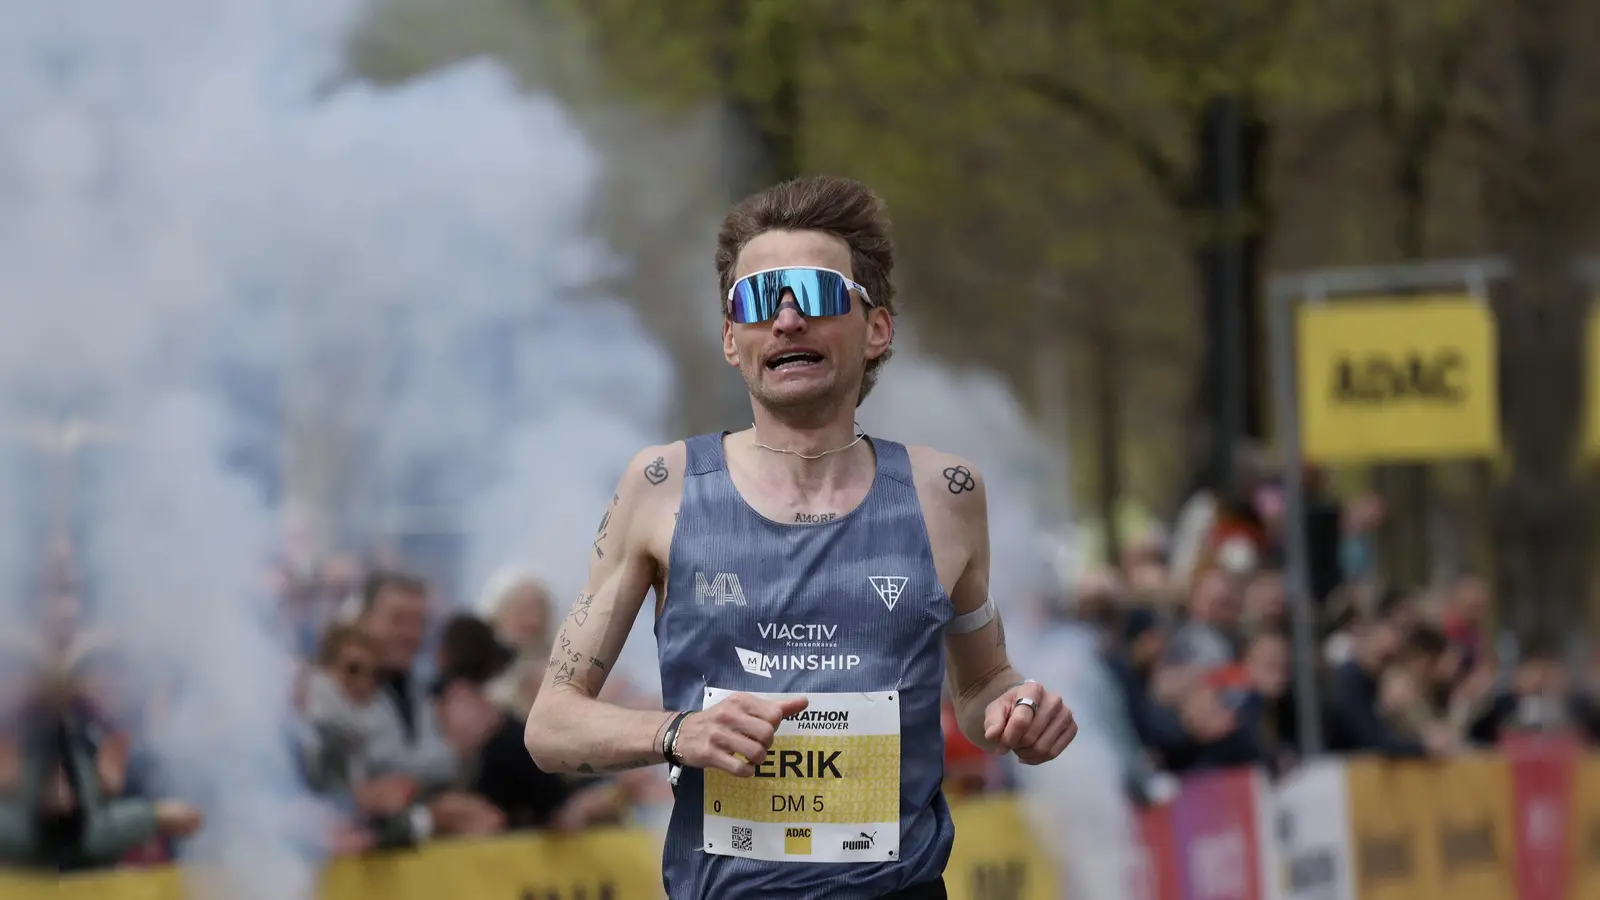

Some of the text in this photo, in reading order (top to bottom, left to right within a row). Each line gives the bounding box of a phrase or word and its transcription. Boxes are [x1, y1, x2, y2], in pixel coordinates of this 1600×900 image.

[695, 572, 747, 606] MA
[757, 622, 838, 640] VIACTIV
[761, 654, 860, 671] MINSHIP
[782, 711, 849, 722] RATHON
[797, 722, 849, 730] HANNOVER
[754, 750, 843, 779] ERIK
[713, 800, 722, 813] 0
[772, 795, 824, 812] DM 5
[786, 828, 811, 838] ADAC
[842, 840, 870, 850] PUMA
